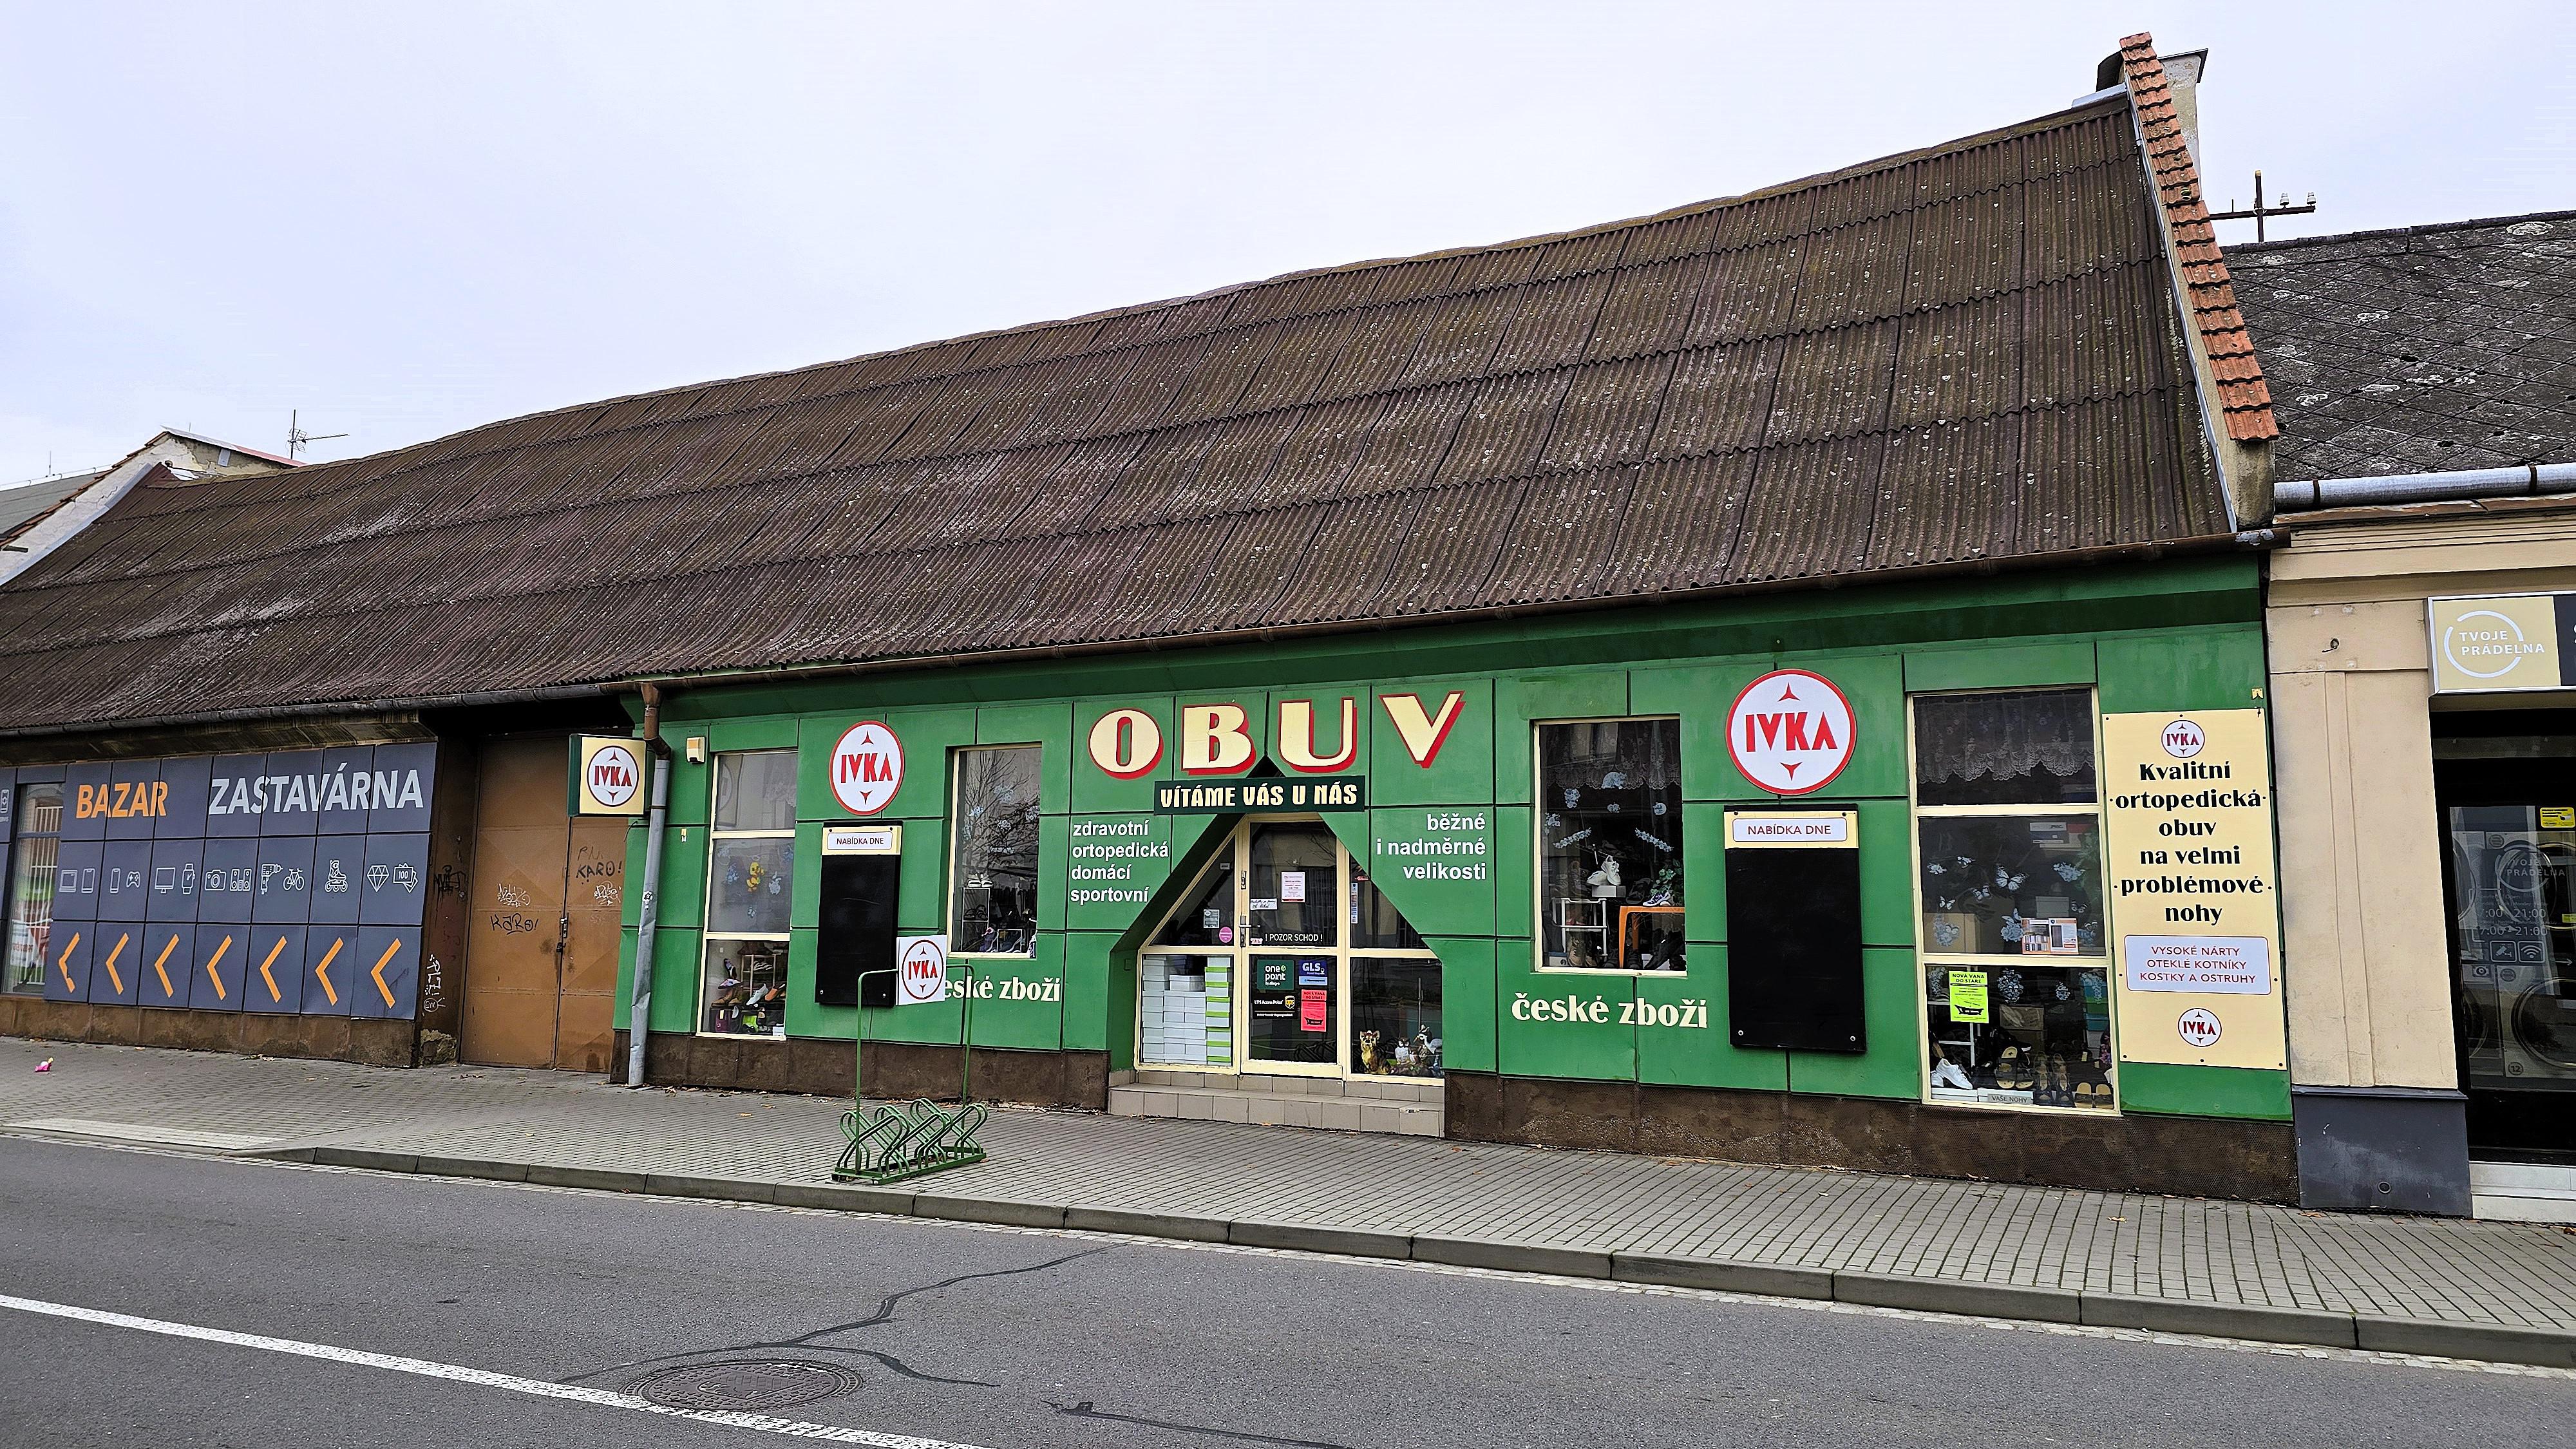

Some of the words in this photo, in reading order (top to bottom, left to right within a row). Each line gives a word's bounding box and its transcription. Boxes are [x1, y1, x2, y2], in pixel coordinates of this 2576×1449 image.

[2459, 630, 2508, 641] TVOJE
[2461, 643, 2544, 656] PRÁDELNA
[1088, 690, 1465, 780] OBUV
[1745, 711, 1837, 753] IVKA
[2166, 734, 2199, 746] IVKA
[594, 765, 632, 788] IVKA
[840, 752, 893, 784] IVKA
[2139, 761, 2231, 781] Kvalitní
[209, 762, 424, 815] ZASTAVÁRNA
[1160, 784, 1236, 808] VÍTÁME
[1243, 782, 1283, 806] VÁS
[1293, 785, 1305, 805] U
[1314, 781, 1357, 804] NÁS
[76, 781, 168, 819] BAZAR
[2116, 789, 2261, 811] ortopedická
[1072, 819, 1150, 836] zdravotní
[1427, 812, 1486, 831] běžné
[1748, 822, 1802, 836] NABÍDKA
[1806, 824, 1832, 835] DNE
[2159, 819, 2217, 837] obuv
[837, 837, 867, 845] NABÍDKA
[1376, 838, 1382, 855] i
[1388, 837, 1486, 855] nadměrné
[1072, 840, 1169, 862] ortopedická
[2140, 850, 2168, 864] na
[2175, 845, 2240, 864] velmi
[1071, 864, 1132, 880] domácí
[1403, 862, 1486, 880] velikosti
[2121, 875, 2264, 896] problémové
[1070, 886, 1150, 905] sportovní
[2165, 904, 2222, 926] nohy
[2481, 908, 2503, 918] :00
[1269, 933, 1293, 942] POZOR
[1294, 933, 1319, 942] SCHOD
[2151, 945, 2197, 955] VYSOKÉ
[2201, 946, 2240, 956] NÁRTY
[908, 960, 938, 980] IVKA
[1302, 962, 1320, 972] GLS
[2147, 959, 2190, 969] OTEKLÉ
[2194, 959, 2247, 970] KOTNÍKY
[1265, 972, 1286, 981] point
[2140, 972, 2185, 982] KOSTKY
[2201, 974, 2256, 983] OSTRUHY
[945, 975, 994, 999] eské
[999, 976, 1061, 1001] zboží
[1511, 992, 1609, 1023] české
[1618, 997, 1707, 1029] zboží
[2183, 1021, 2217, 1036] IVKA
